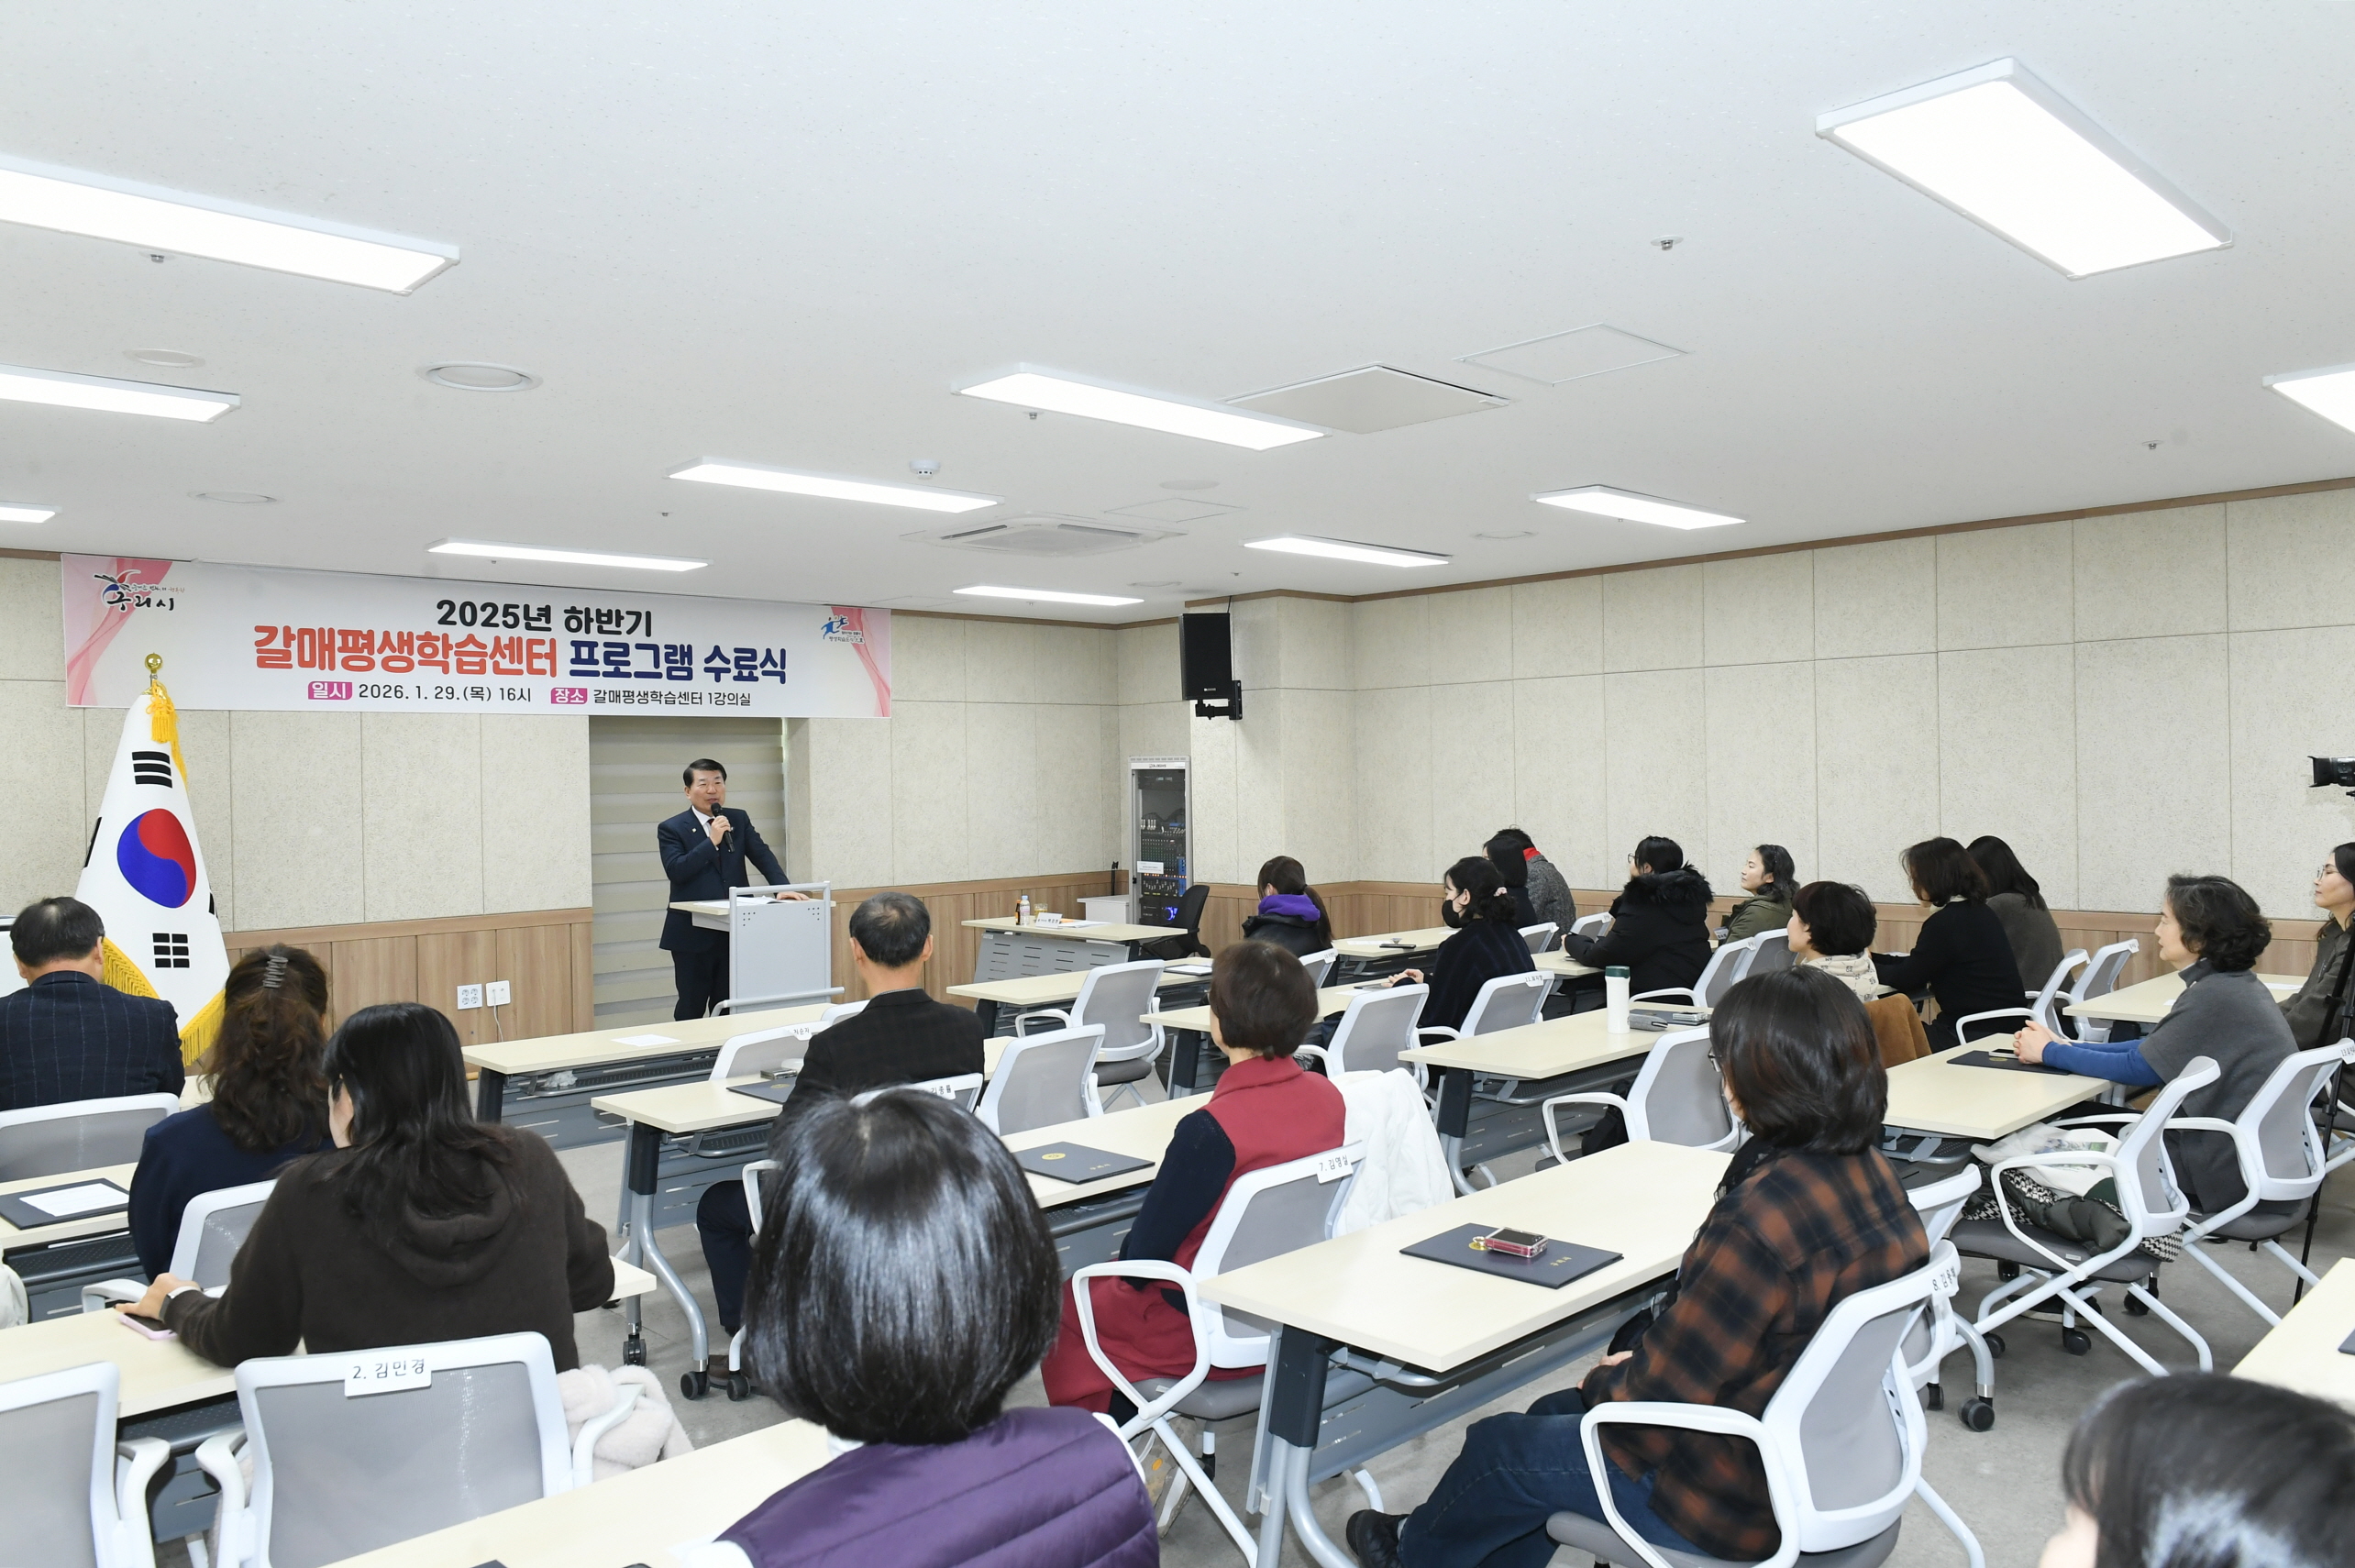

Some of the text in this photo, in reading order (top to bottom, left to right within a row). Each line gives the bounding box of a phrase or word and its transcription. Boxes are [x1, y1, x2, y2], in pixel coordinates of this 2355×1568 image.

[106, 591, 174, 612] 구리시
[436, 599, 652, 638] 2025년 하반기
[254, 625, 787, 685] 갈매평생학습센터 프로그램 수료식
[311, 682, 751, 707] 일시 2026. 1. 29.(목) 16시 장소 갈매평생학습센터 1강의실
[352, 1357, 425, 1380] 2. 김민경
